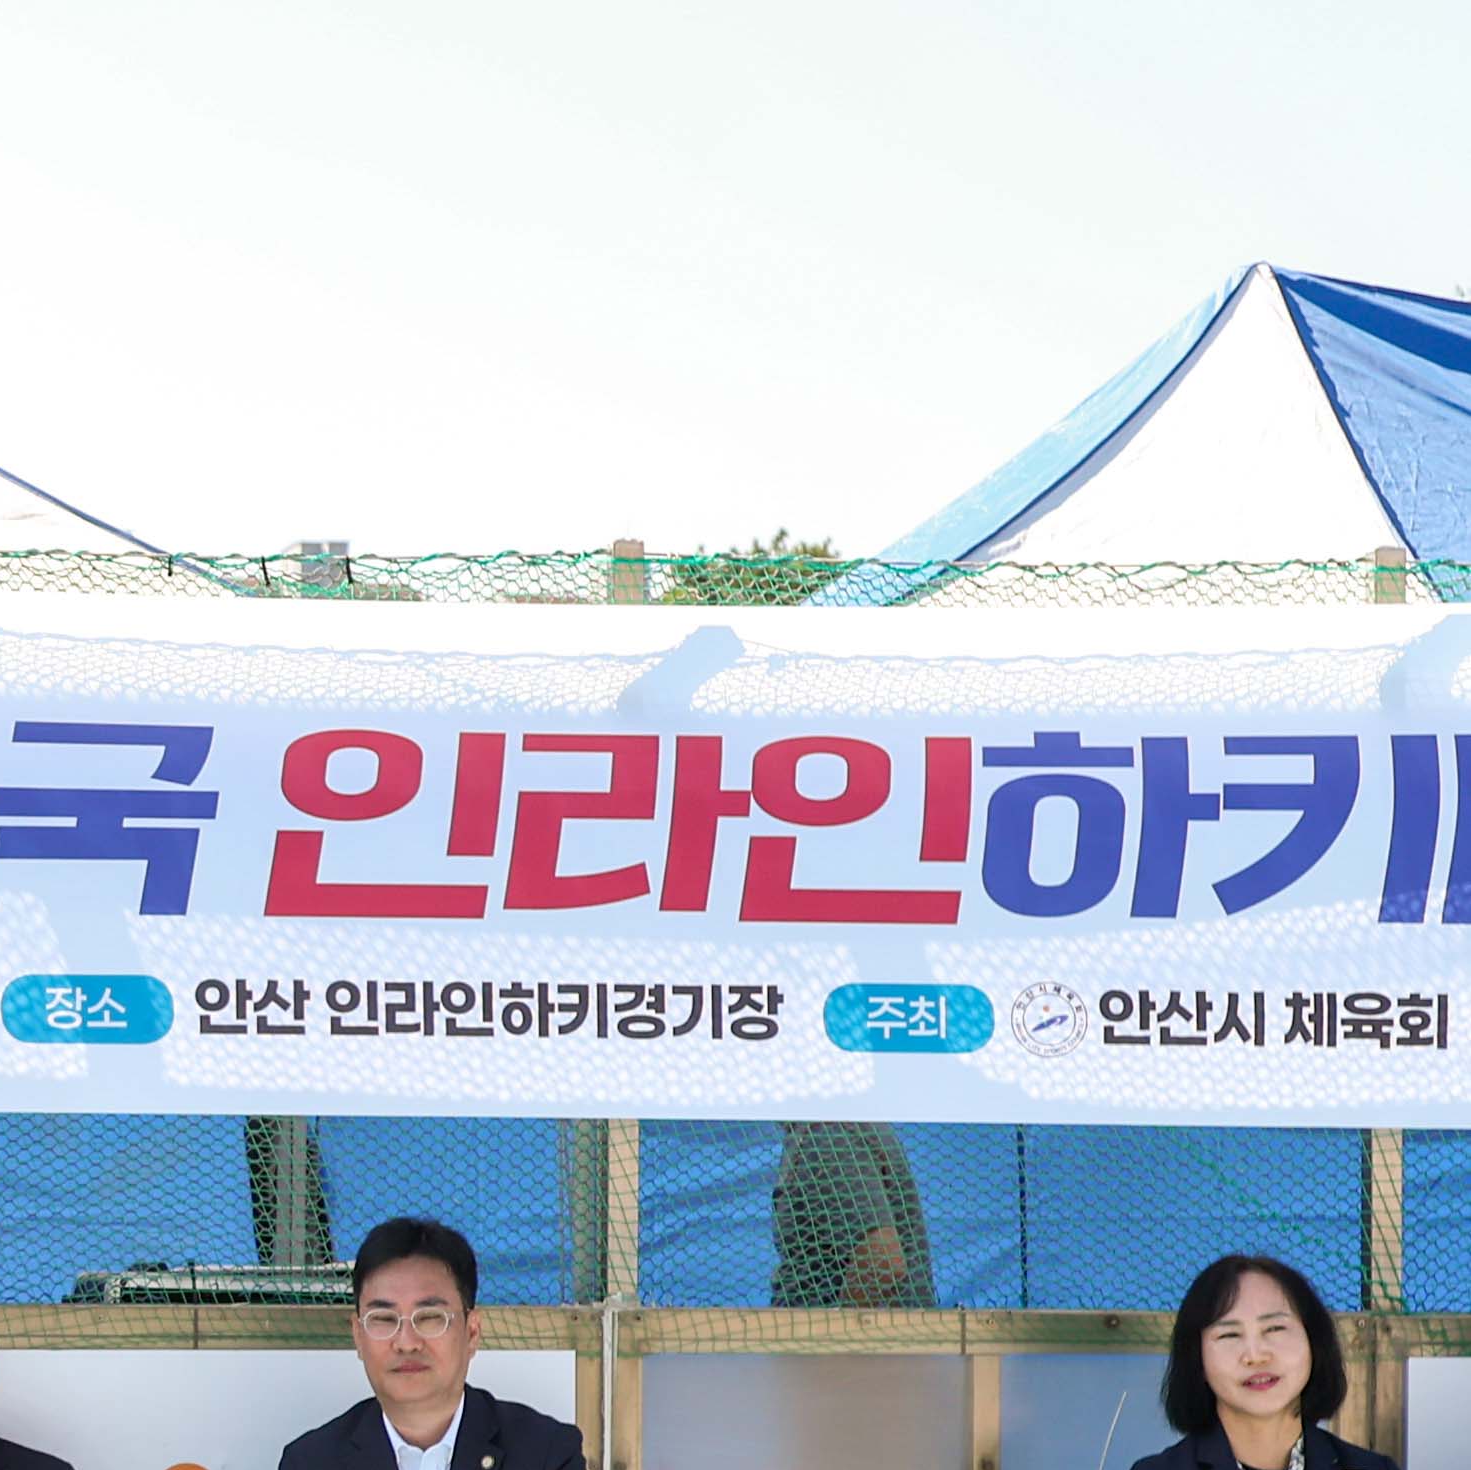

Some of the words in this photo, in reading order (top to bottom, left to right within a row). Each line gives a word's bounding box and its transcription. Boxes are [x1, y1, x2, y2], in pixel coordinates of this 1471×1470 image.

[263, 728, 1471, 925] 인라인하키
[44, 984, 129, 1031] 장소
[194, 977, 311, 1036] 안산
[330, 979, 784, 1042] 인라인하키경기장
[866, 993, 948, 1041] 주최
[1099, 988, 1265, 1048] 안산시
[1283, 990, 1448, 1051] 체육회
